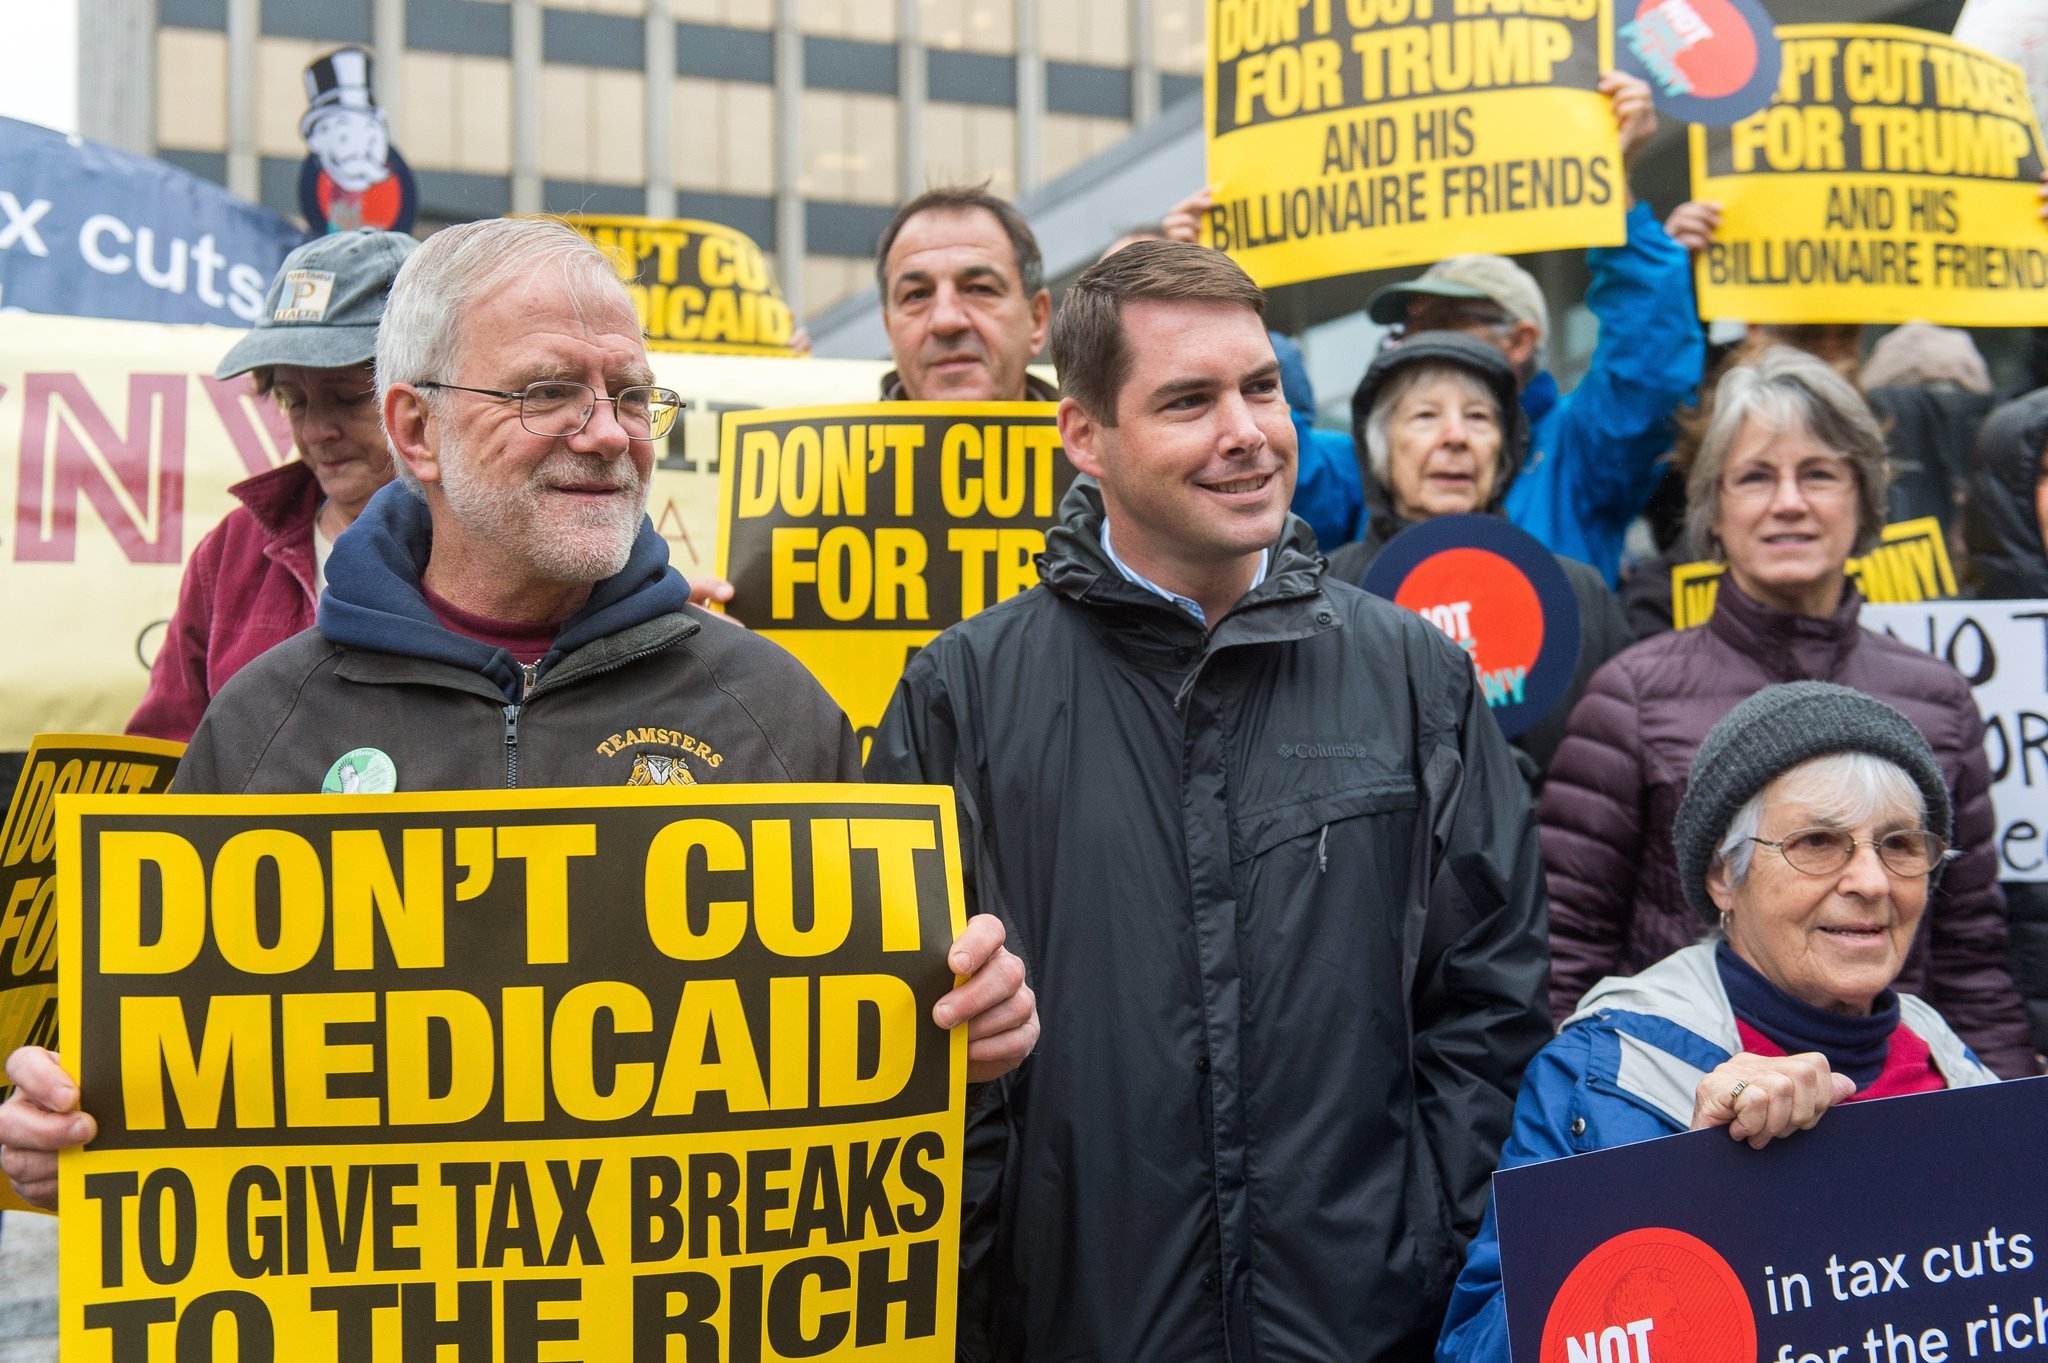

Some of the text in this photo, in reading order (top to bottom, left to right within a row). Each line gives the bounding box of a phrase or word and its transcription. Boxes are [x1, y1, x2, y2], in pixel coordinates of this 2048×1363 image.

[1234, 17, 1573, 126] FOR TRUMP
[1843, 38, 1926, 105] CUT
[1323, 106, 1475, 175] AND HIS
[1732, 104, 2031, 179] FOR TRUMP
[1209, 156, 1612, 252] BILLIONAIRE FRIENDS
[1825, 186, 1960, 234] AND HIS
[79, 213, 266, 322] cuts
[1708, 239, 1921, 286] BILLIONAIRE
[738, 423, 926, 519] DON'T
[941, 422, 1063, 518] CUT
[772, 525, 930, 621] FOR
[596, 727, 724, 768] TEAMSTERS
[1295, 742, 1367, 759] Columbia
[0, 873, 58, 977] FO
[99, 818, 936, 974] DON'T CUT
[120, 974, 917, 1131] MEDICAID
[84, 1131, 945, 1289] TO GIVE TAX BREAKS
[84, 1240, 940, 1363] TO THE RICH
[1764, 1226, 2035, 1316] in tax cuts
[1863, 1323, 1950, 1363] the
